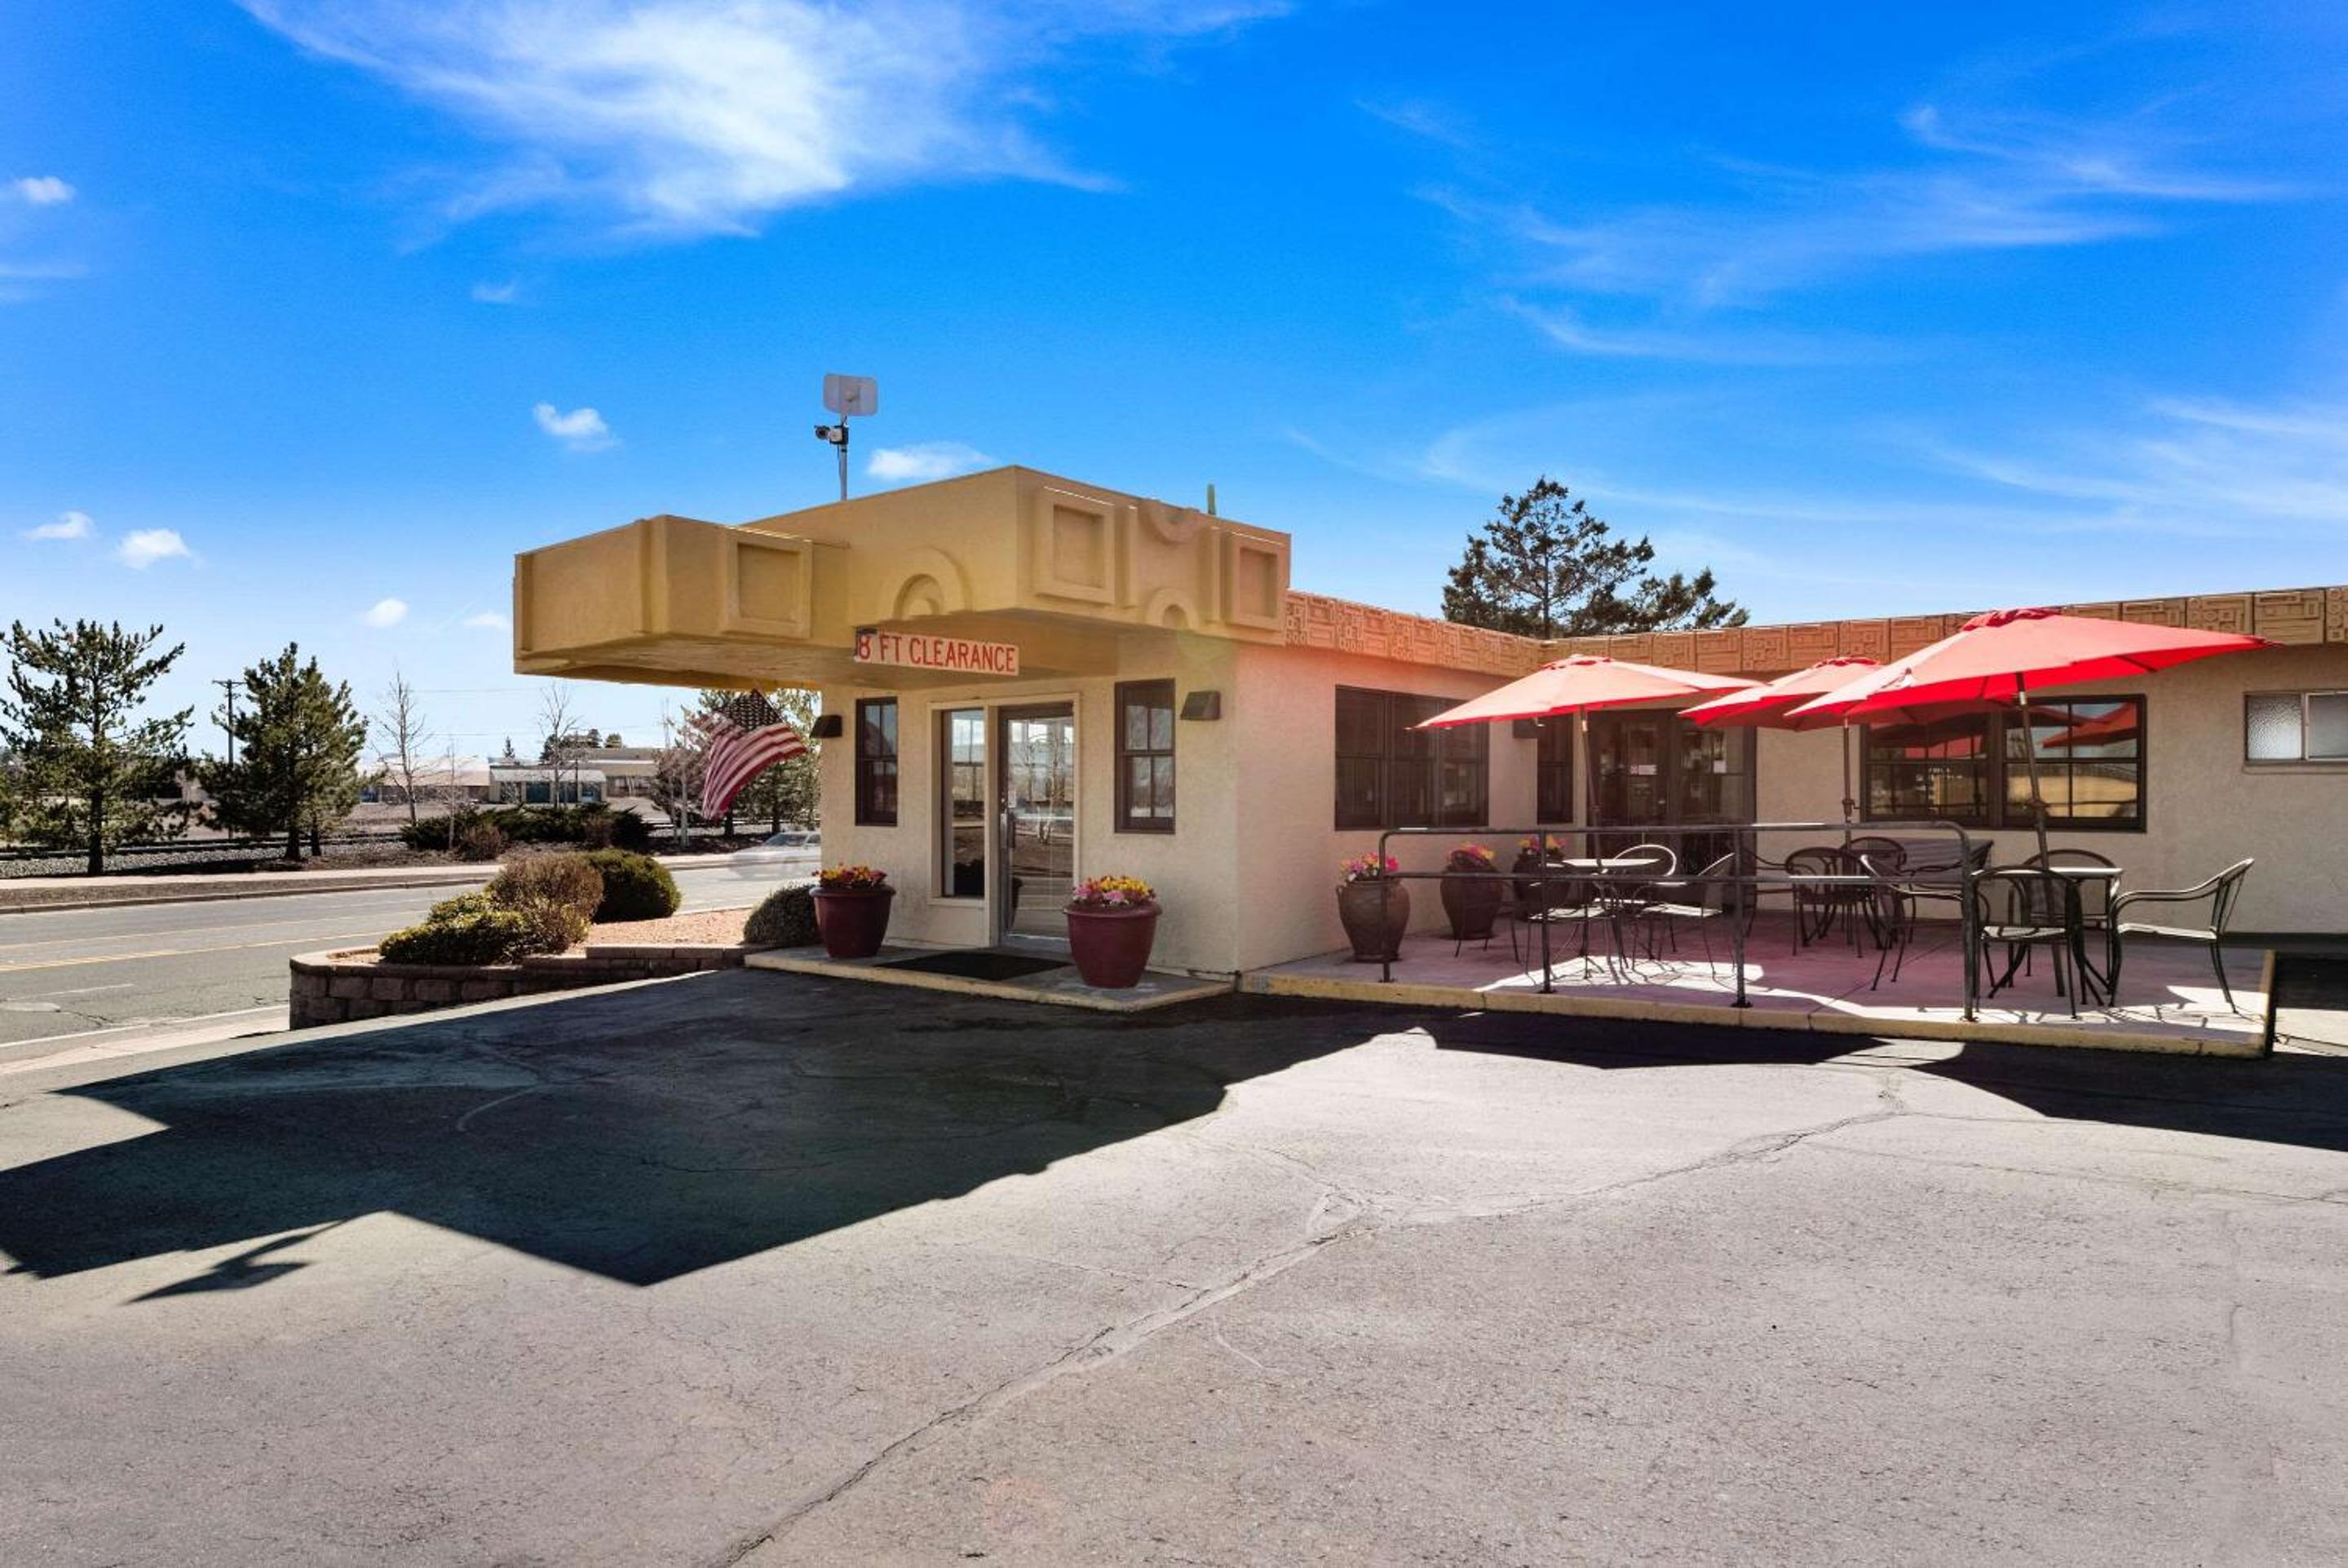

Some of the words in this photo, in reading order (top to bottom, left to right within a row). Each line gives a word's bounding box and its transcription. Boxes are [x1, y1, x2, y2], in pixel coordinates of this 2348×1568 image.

[858, 635, 871, 660] 8
[879, 634, 902, 662] FT
[909, 638, 1016, 673] CLEARANCE
